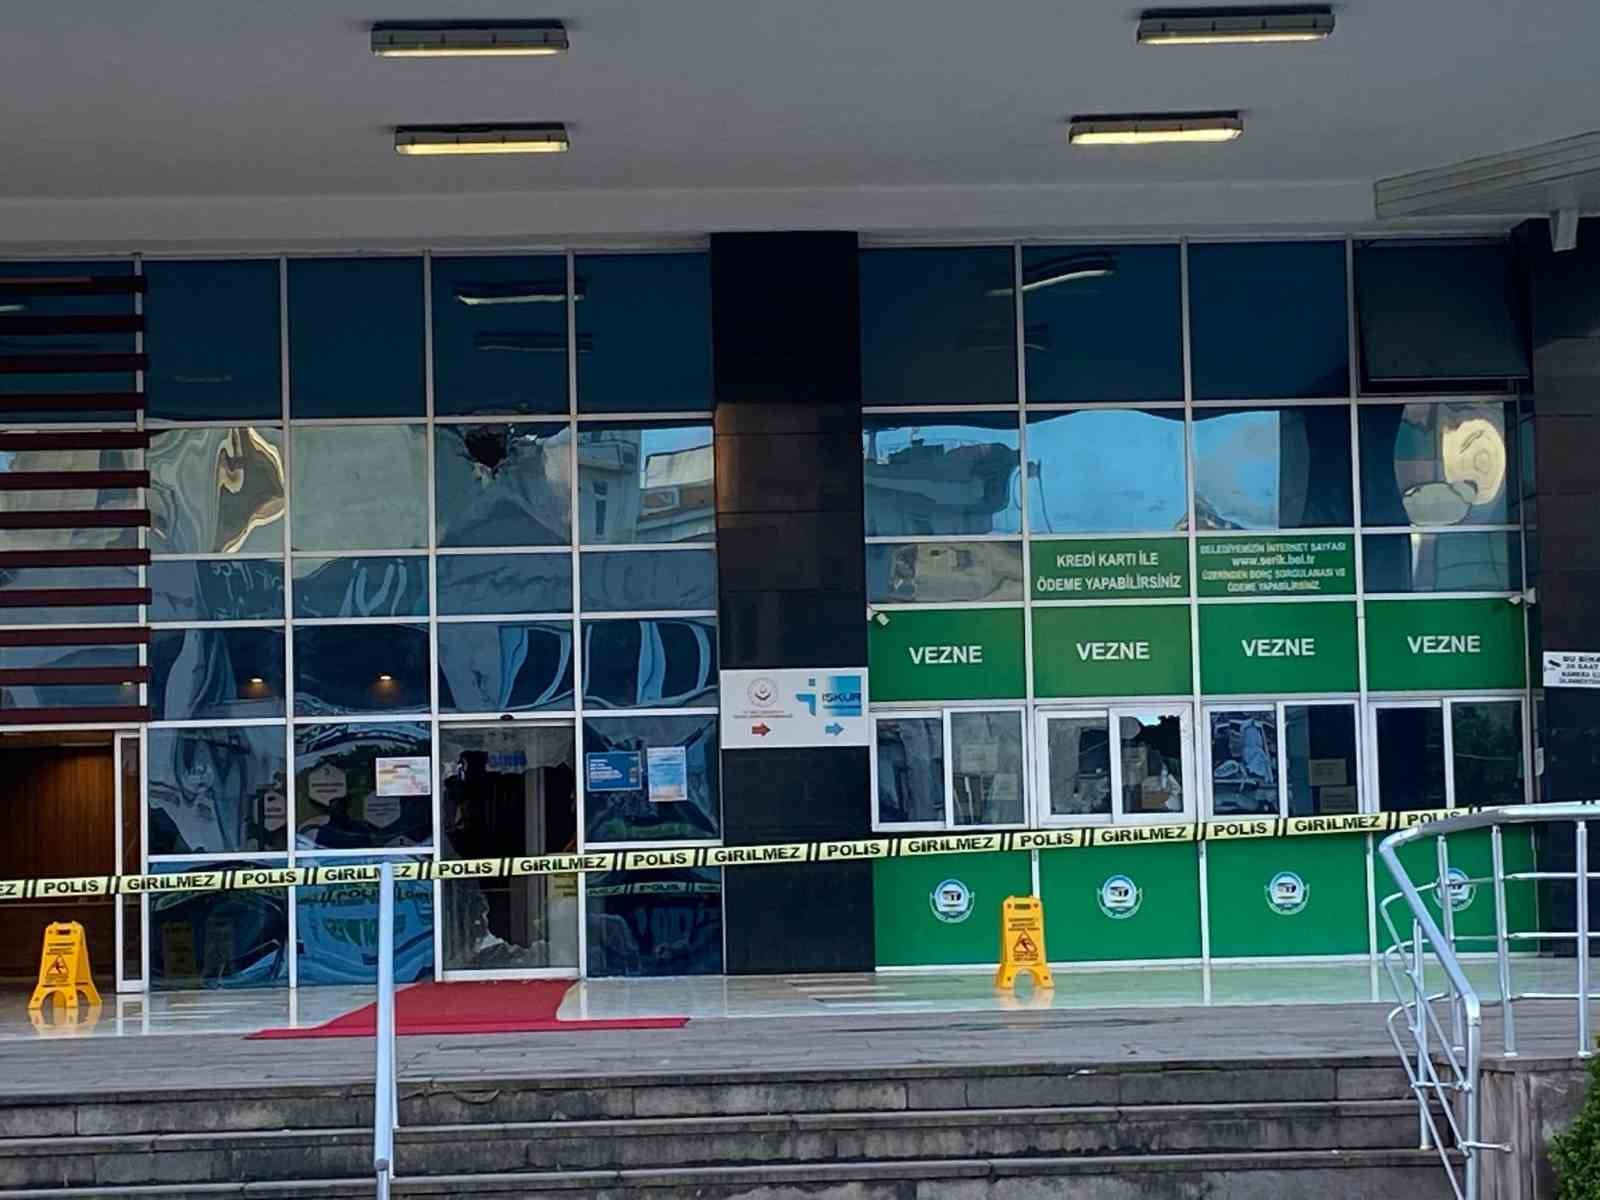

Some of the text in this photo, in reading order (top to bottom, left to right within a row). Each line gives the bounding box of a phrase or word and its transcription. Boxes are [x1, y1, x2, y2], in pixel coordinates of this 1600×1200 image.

[1056, 549, 1159, 567] KREDİ KARTI İLE
[1036, 571, 1182, 591] ÖDEME YAPABİLİRSİNİZ
[1076, 642, 1150, 660] VEZNE
[1241, 638, 1315, 656] VEZNE
[1407, 635, 1481, 653] VEZNE
[909, 645, 984, 664] VEZNE
